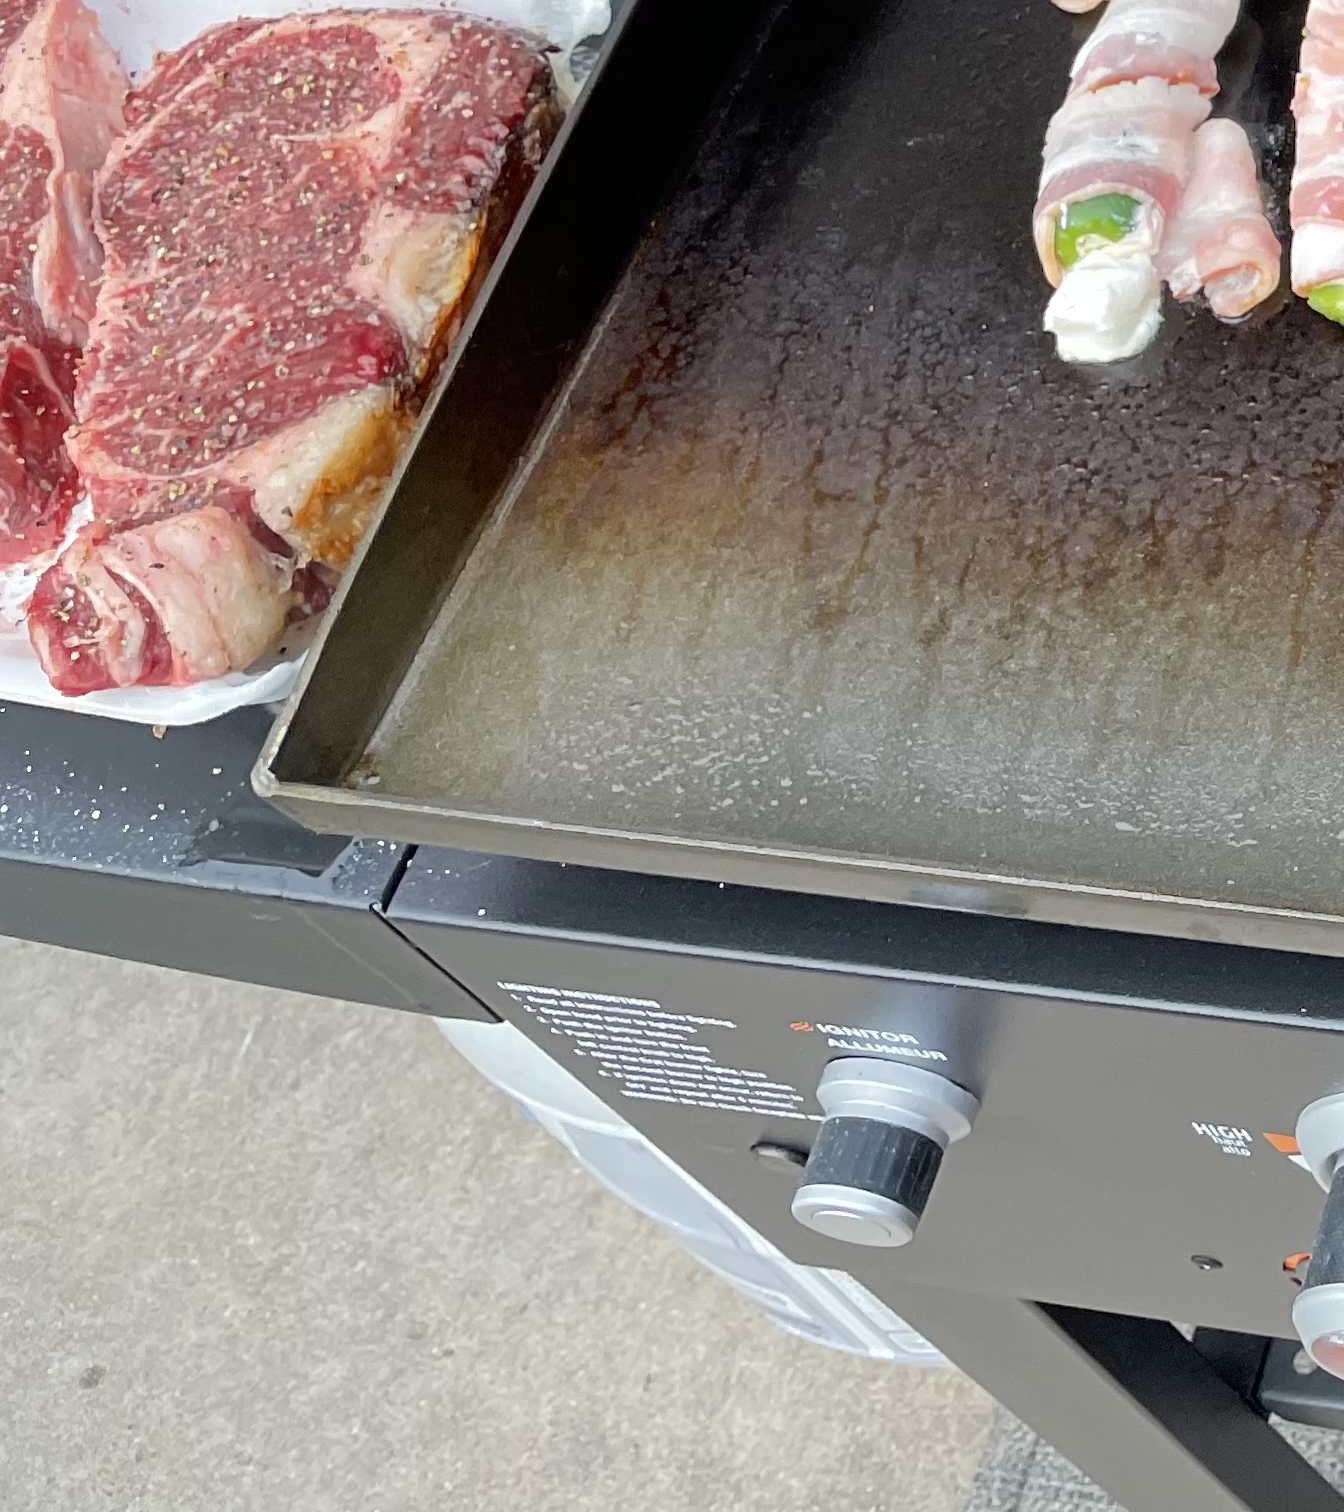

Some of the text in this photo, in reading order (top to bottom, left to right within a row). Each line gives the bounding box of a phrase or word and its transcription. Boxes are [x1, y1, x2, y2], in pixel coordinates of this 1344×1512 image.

[816, 1023, 920, 1045] IGNITOR
[827, 1038, 948, 1061] ALLUMEUR
[1191, 1121, 1253, 1142] HIGH
